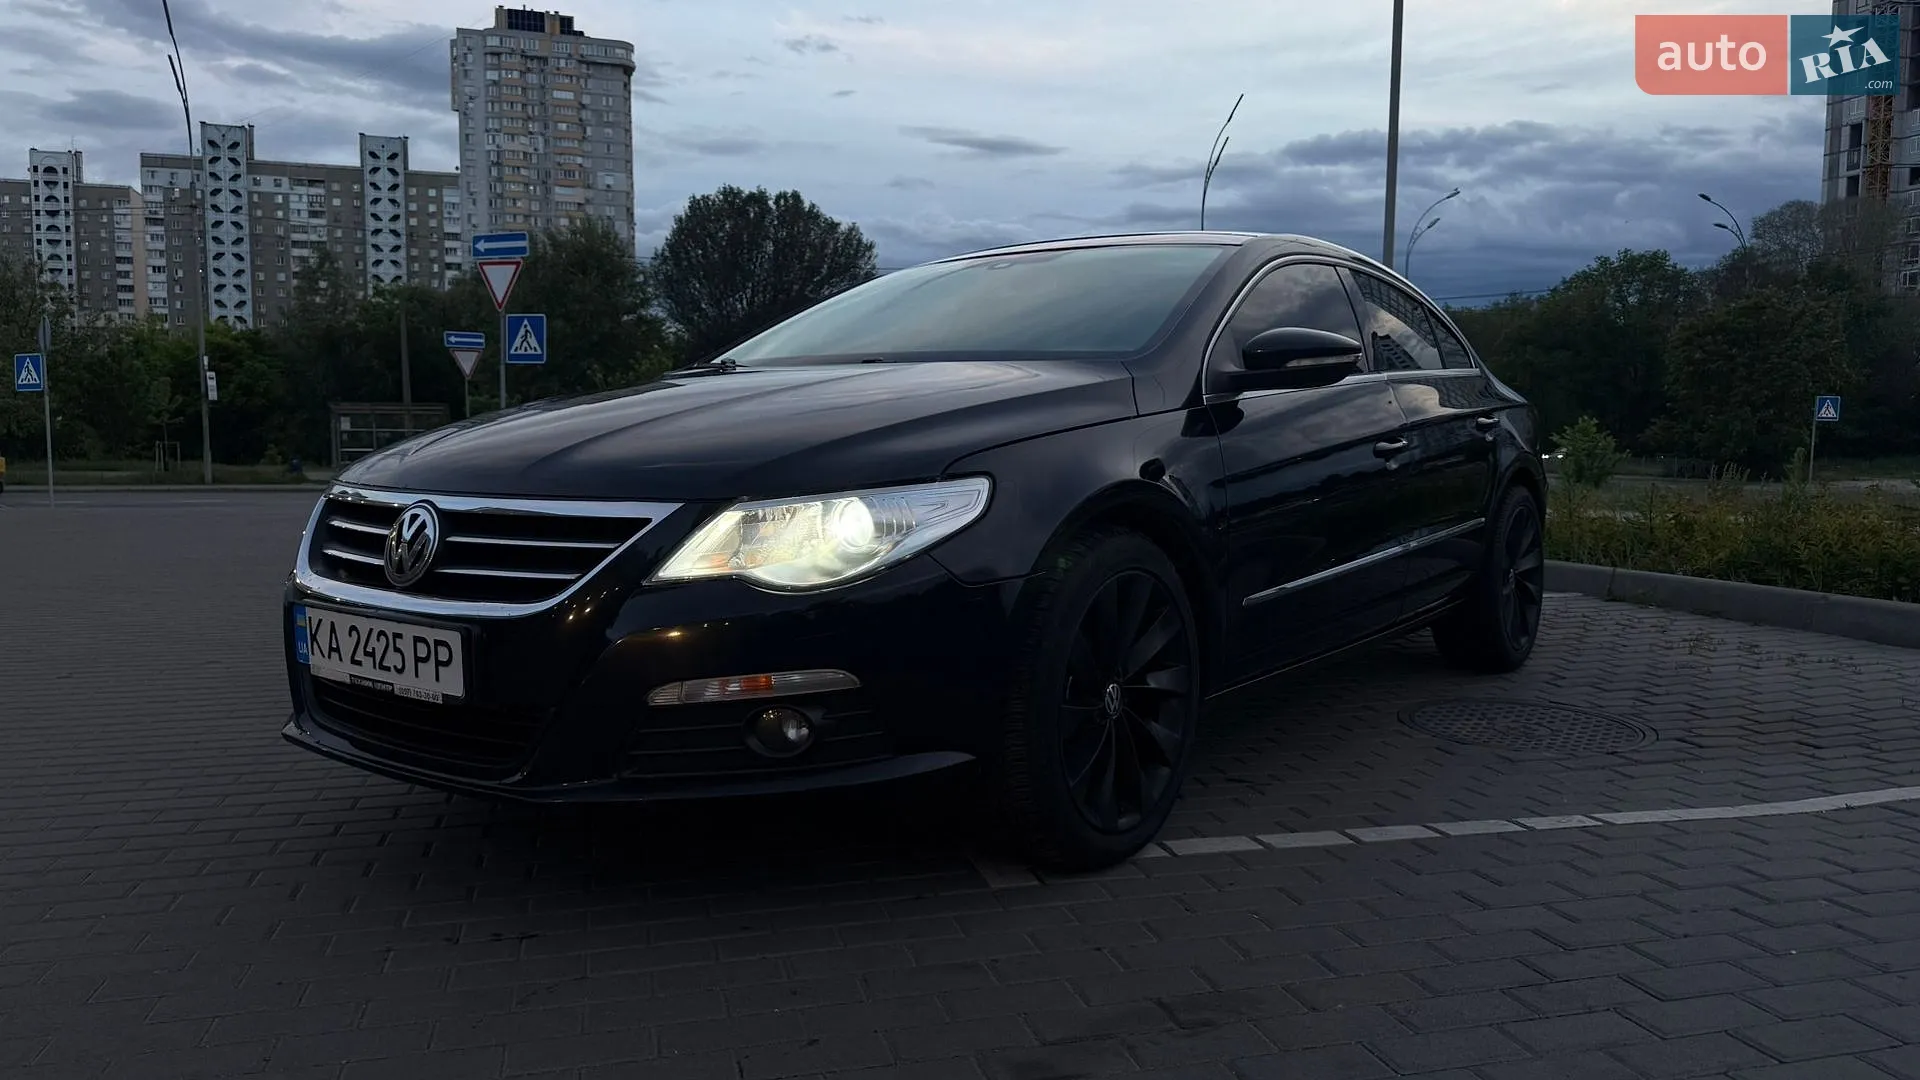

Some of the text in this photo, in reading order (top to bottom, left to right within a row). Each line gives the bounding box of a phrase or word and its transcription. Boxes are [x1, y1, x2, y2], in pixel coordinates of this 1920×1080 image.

[298, 641, 309, 656] UA
[308, 616, 453, 682] KA 2425 PP
